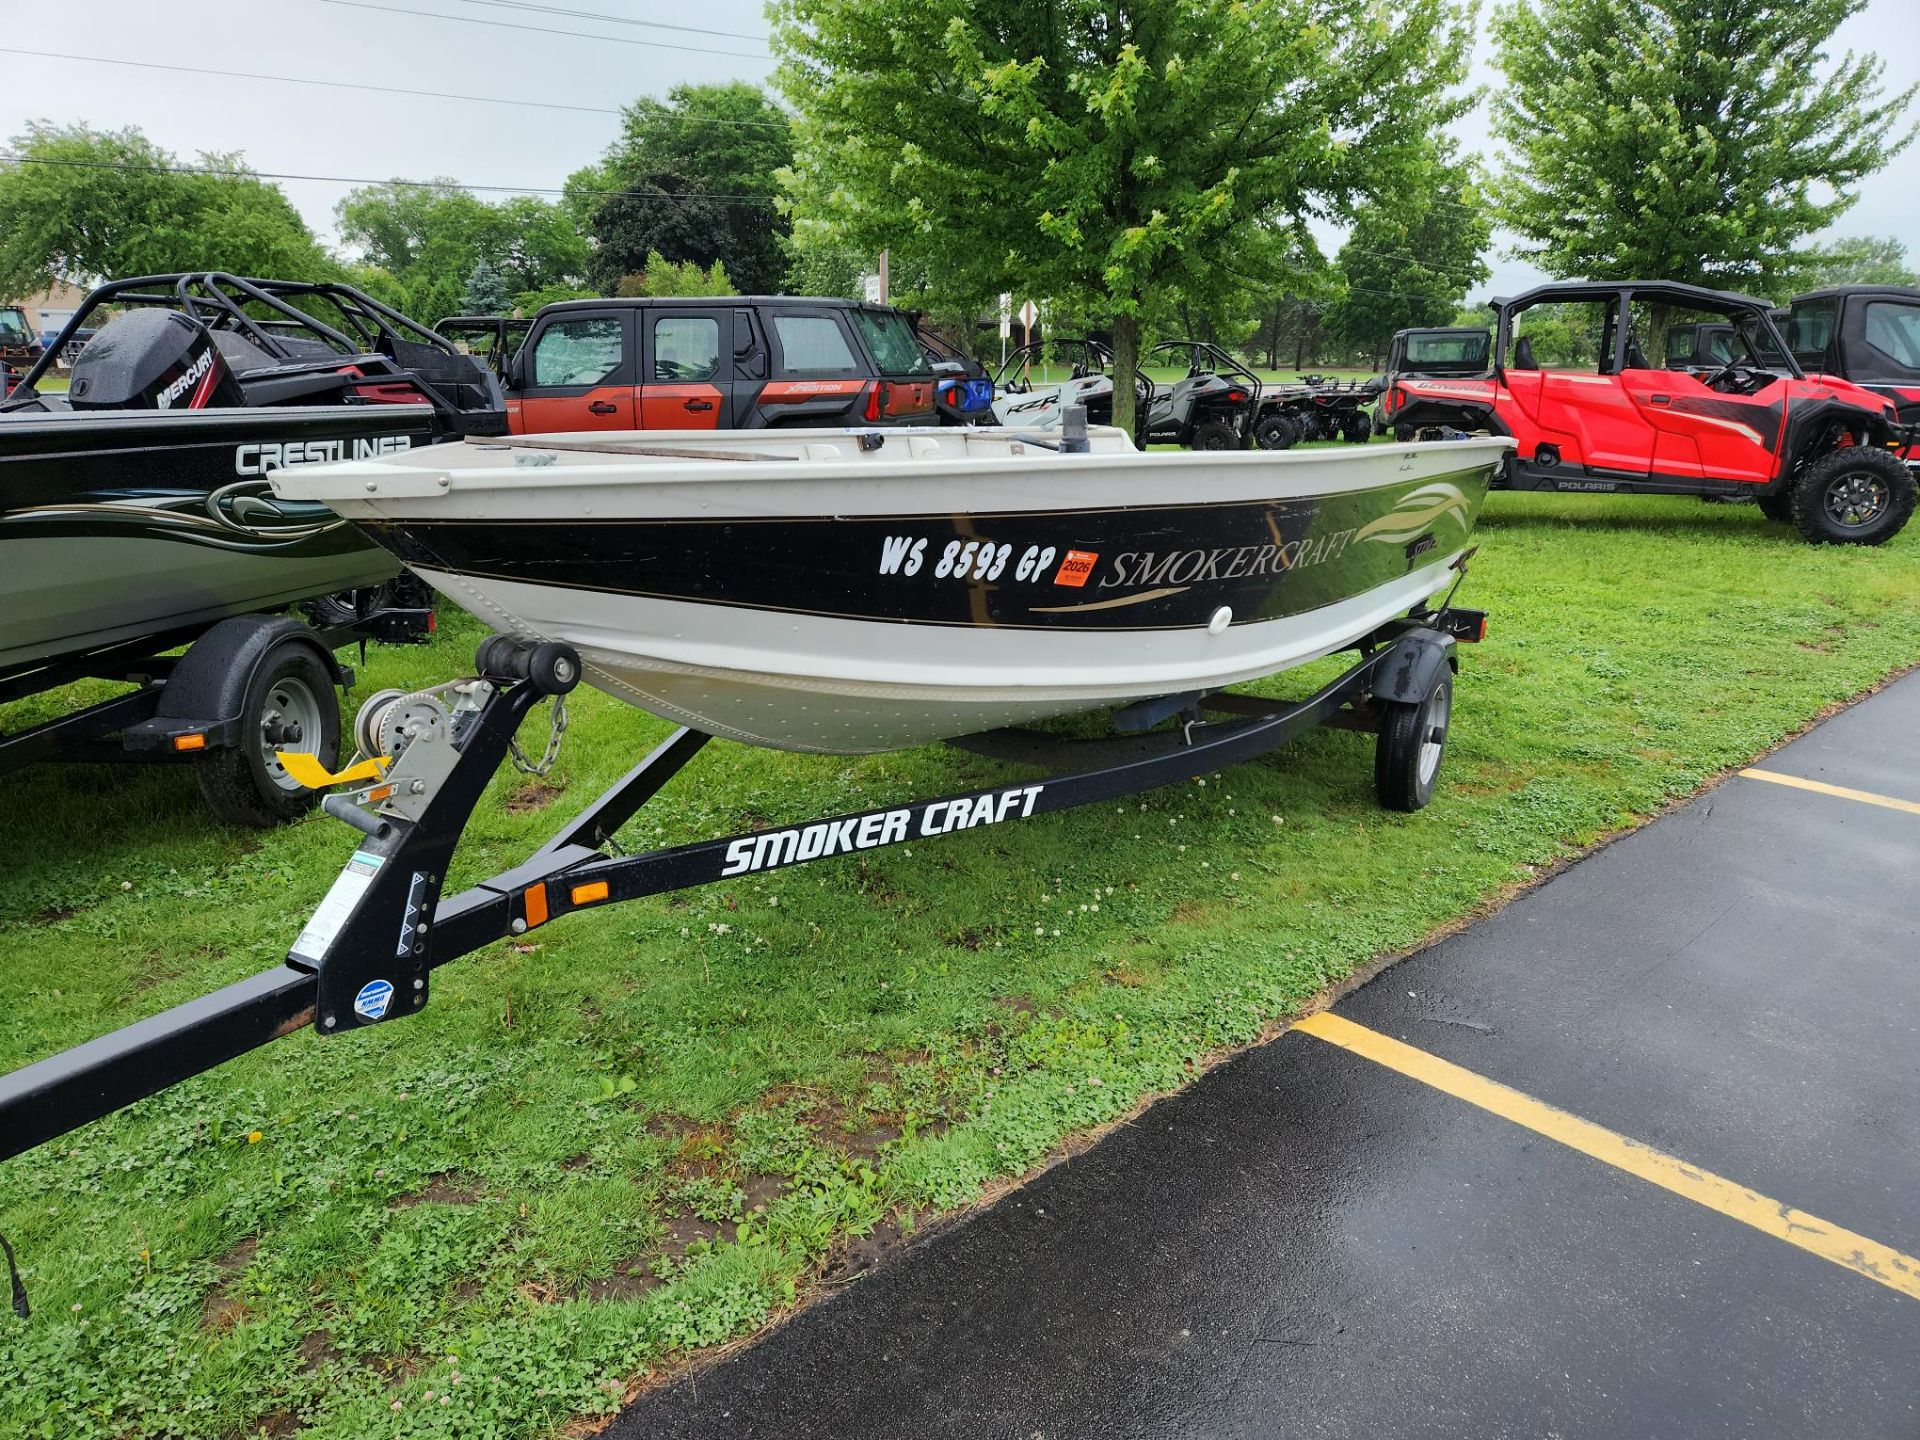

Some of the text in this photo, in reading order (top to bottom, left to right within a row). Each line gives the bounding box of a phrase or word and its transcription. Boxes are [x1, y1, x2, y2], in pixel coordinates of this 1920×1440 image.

[157, 347, 213, 409] MERCURY
[1006, 394, 1060, 416] RZR
[236, 436, 411, 475] CRESTLINER
[1558, 481, 1616, 491] POLARIS
[879, 536, 1056, 583] WS 8593 GP
[1063, 560, 1091, 573] 2026
[1098, 528, 1357, 588] SMOKERCRAFT
[721, 785, 1044, 877] SMOKER CRAFT
